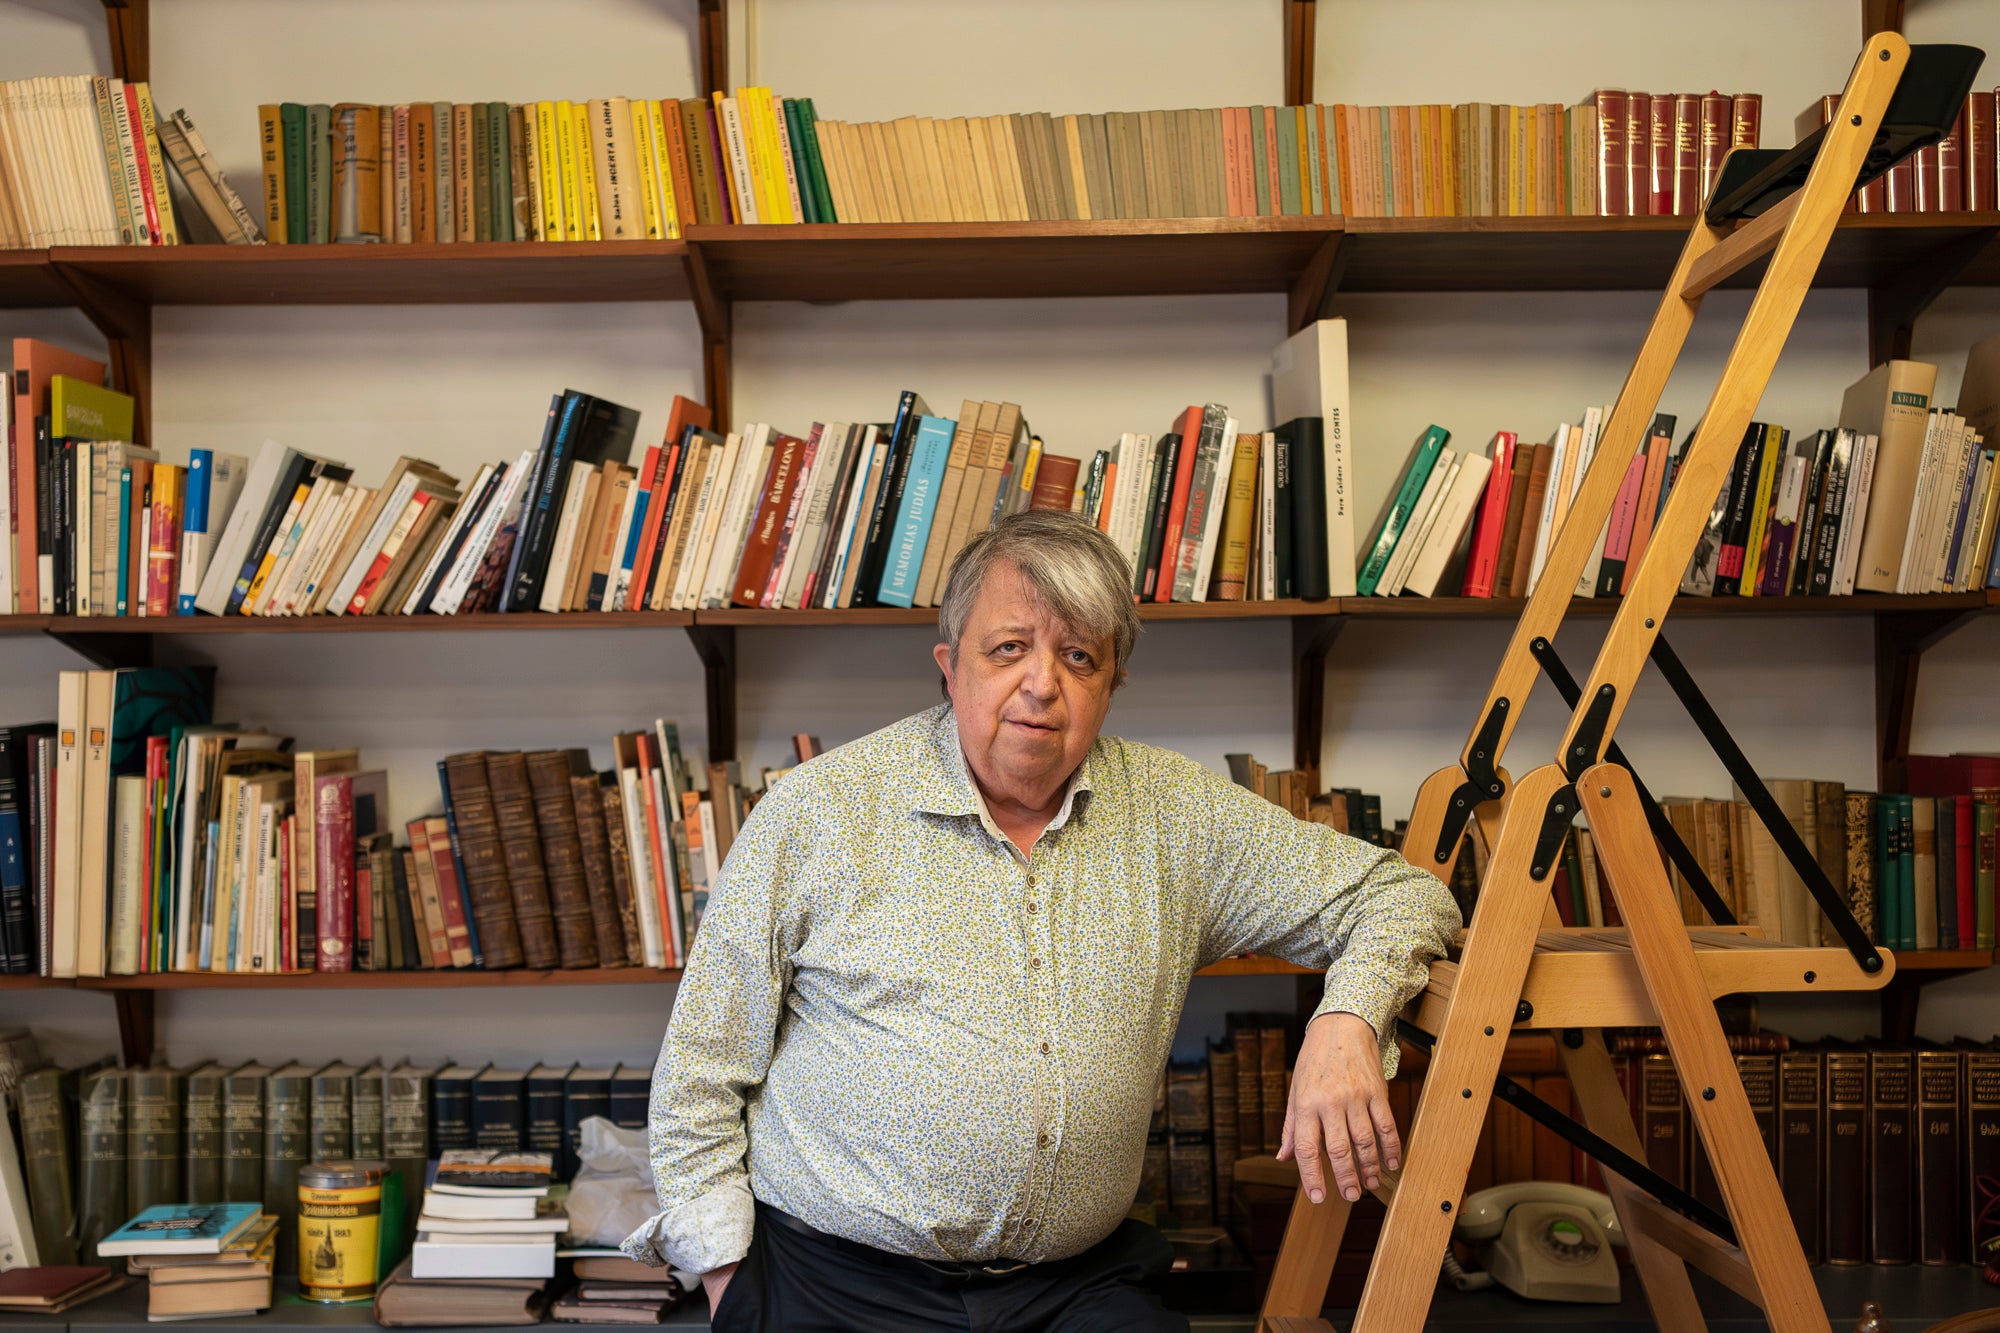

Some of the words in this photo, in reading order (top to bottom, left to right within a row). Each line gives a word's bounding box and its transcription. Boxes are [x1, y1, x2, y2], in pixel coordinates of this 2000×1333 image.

[263, 118, 275, 143] MAR
[605, 140, 618, 185] INCERTA
[1332, 406, 1341, 439] CONTES
[1334, 442, 1342, 453] 20
[541, 455, 564, 495] cinemes
[768, 439, 796, 504] BARCELONA
[1334, 464, 1344, 494] Calders
[1337, 498, 1345, 515] Pere
[891, 522, 919, 588] MEMORIAS
[906, 477, 932, 522] JUDÍAS
